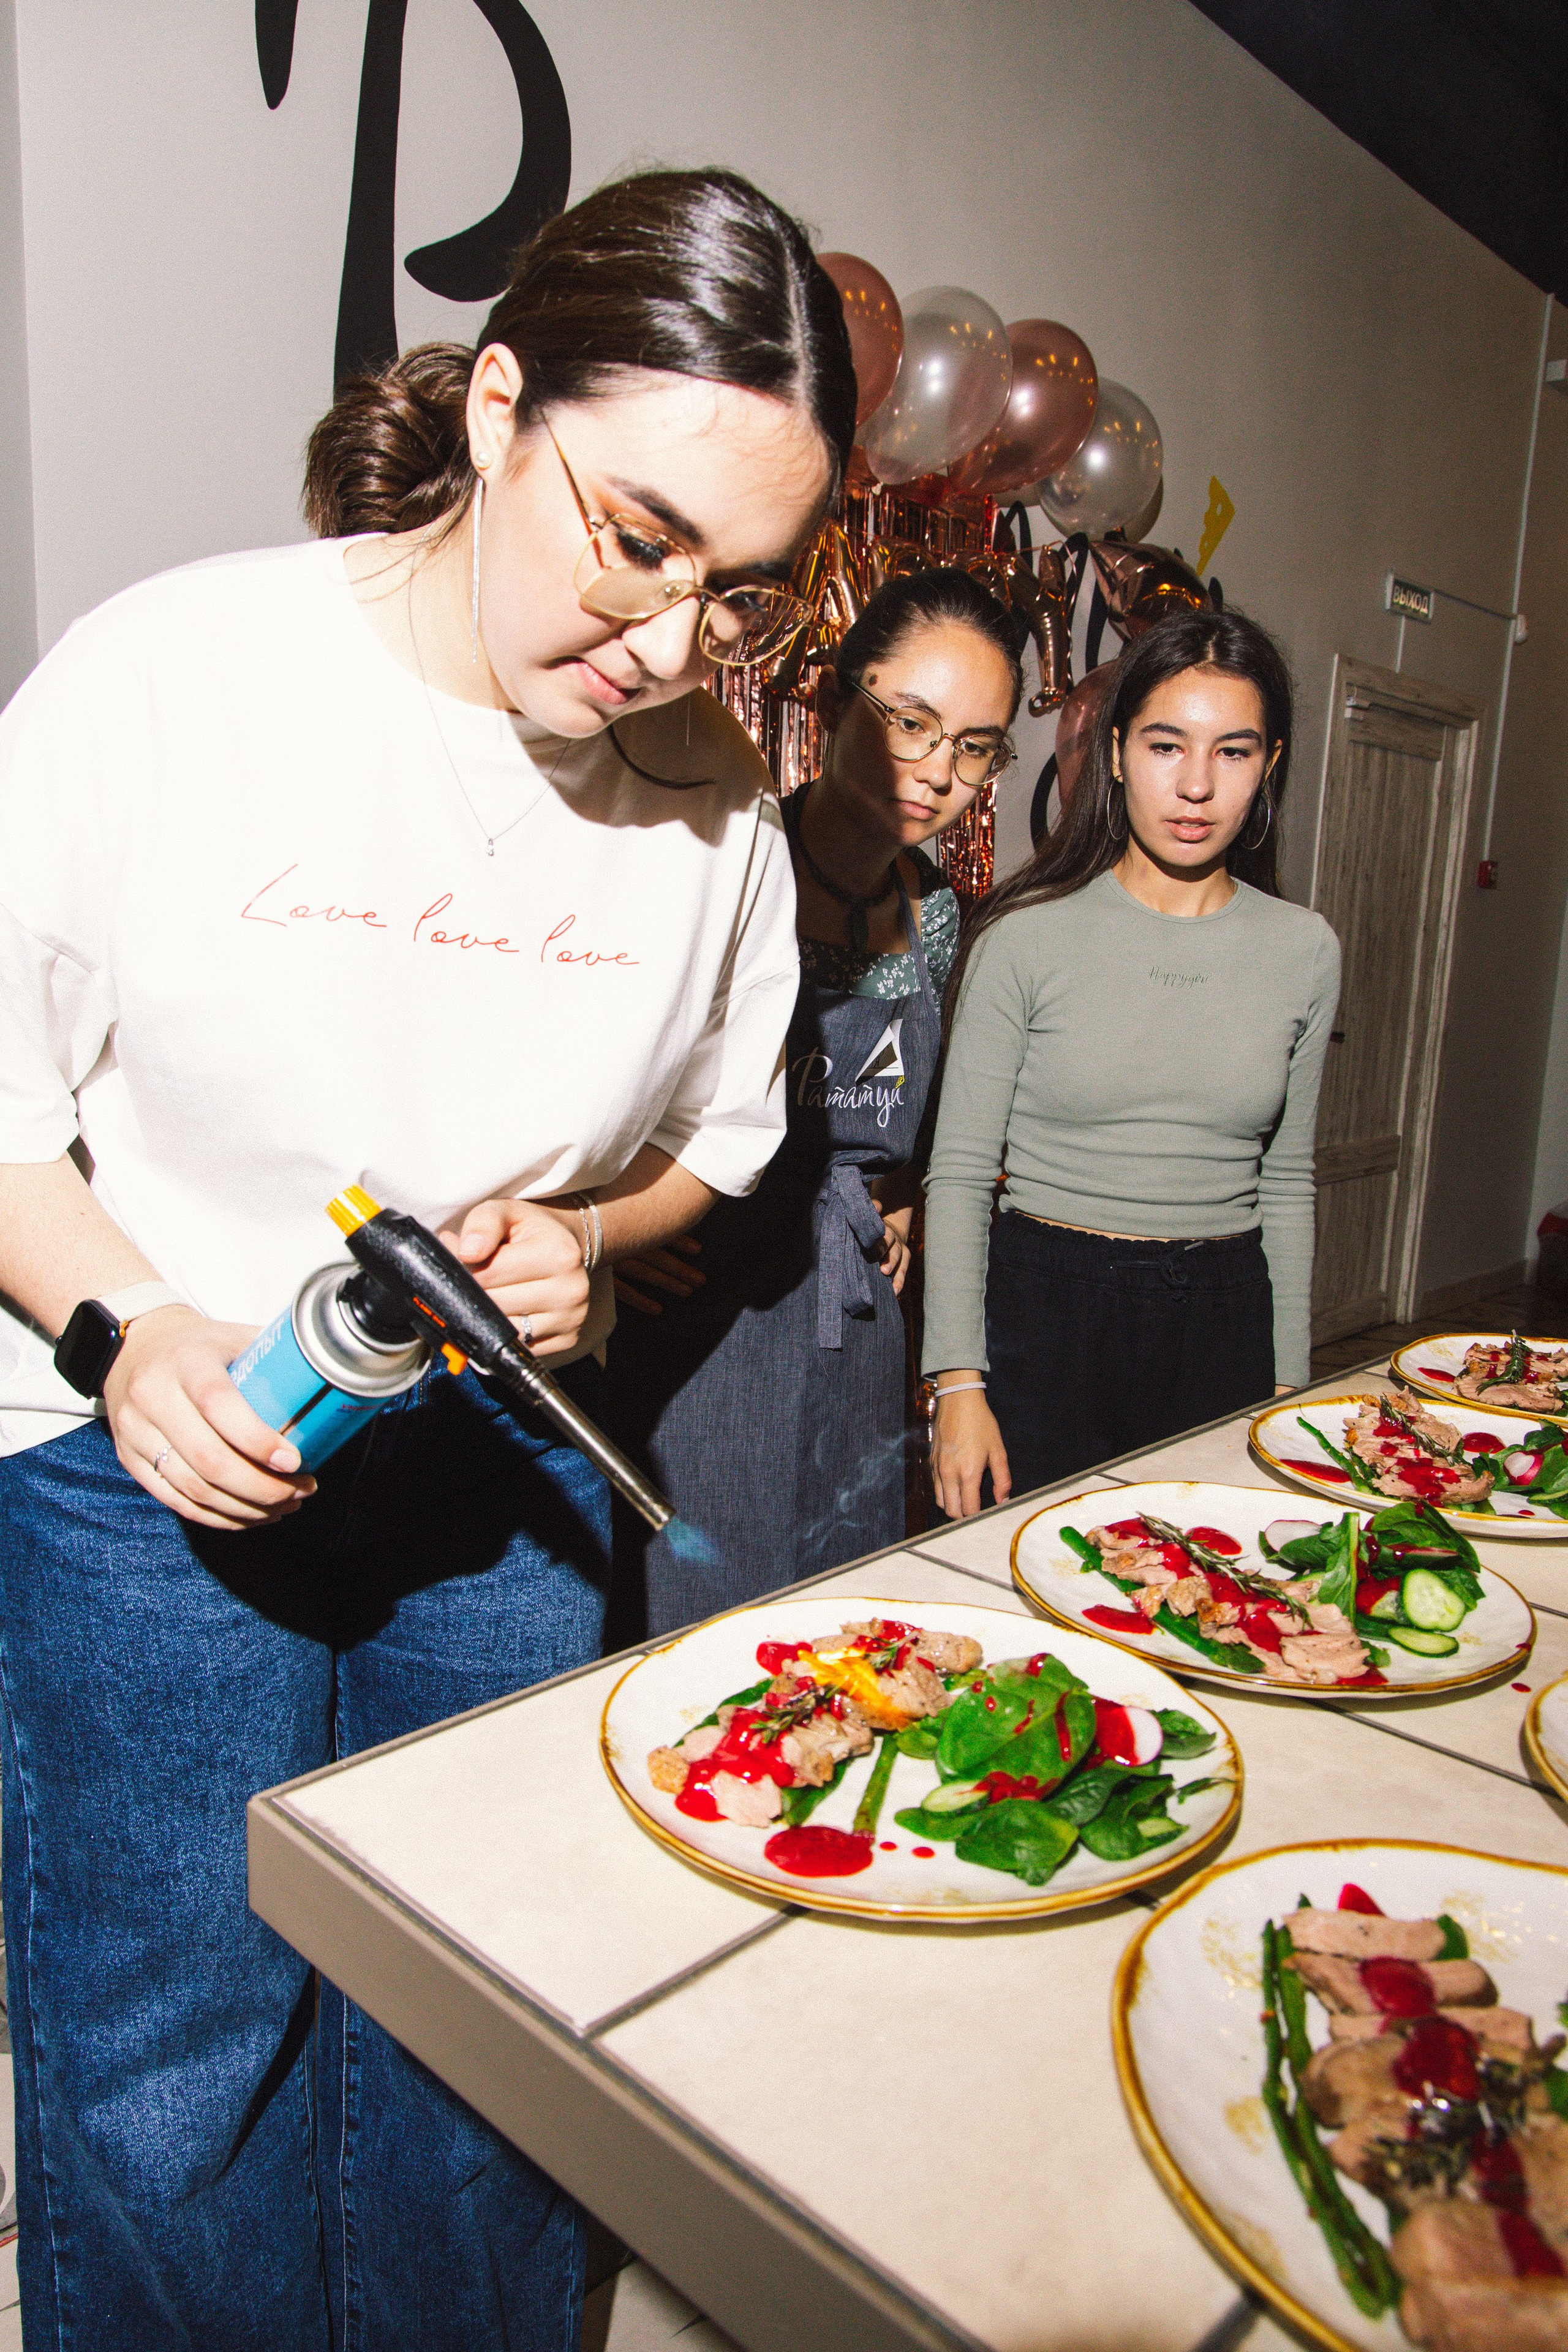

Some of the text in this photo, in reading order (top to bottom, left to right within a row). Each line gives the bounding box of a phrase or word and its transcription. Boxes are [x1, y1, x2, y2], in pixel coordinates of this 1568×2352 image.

[1393, 586, 1428, 614] ВЫХОД
[241, 864, 639, 965] Love love love
